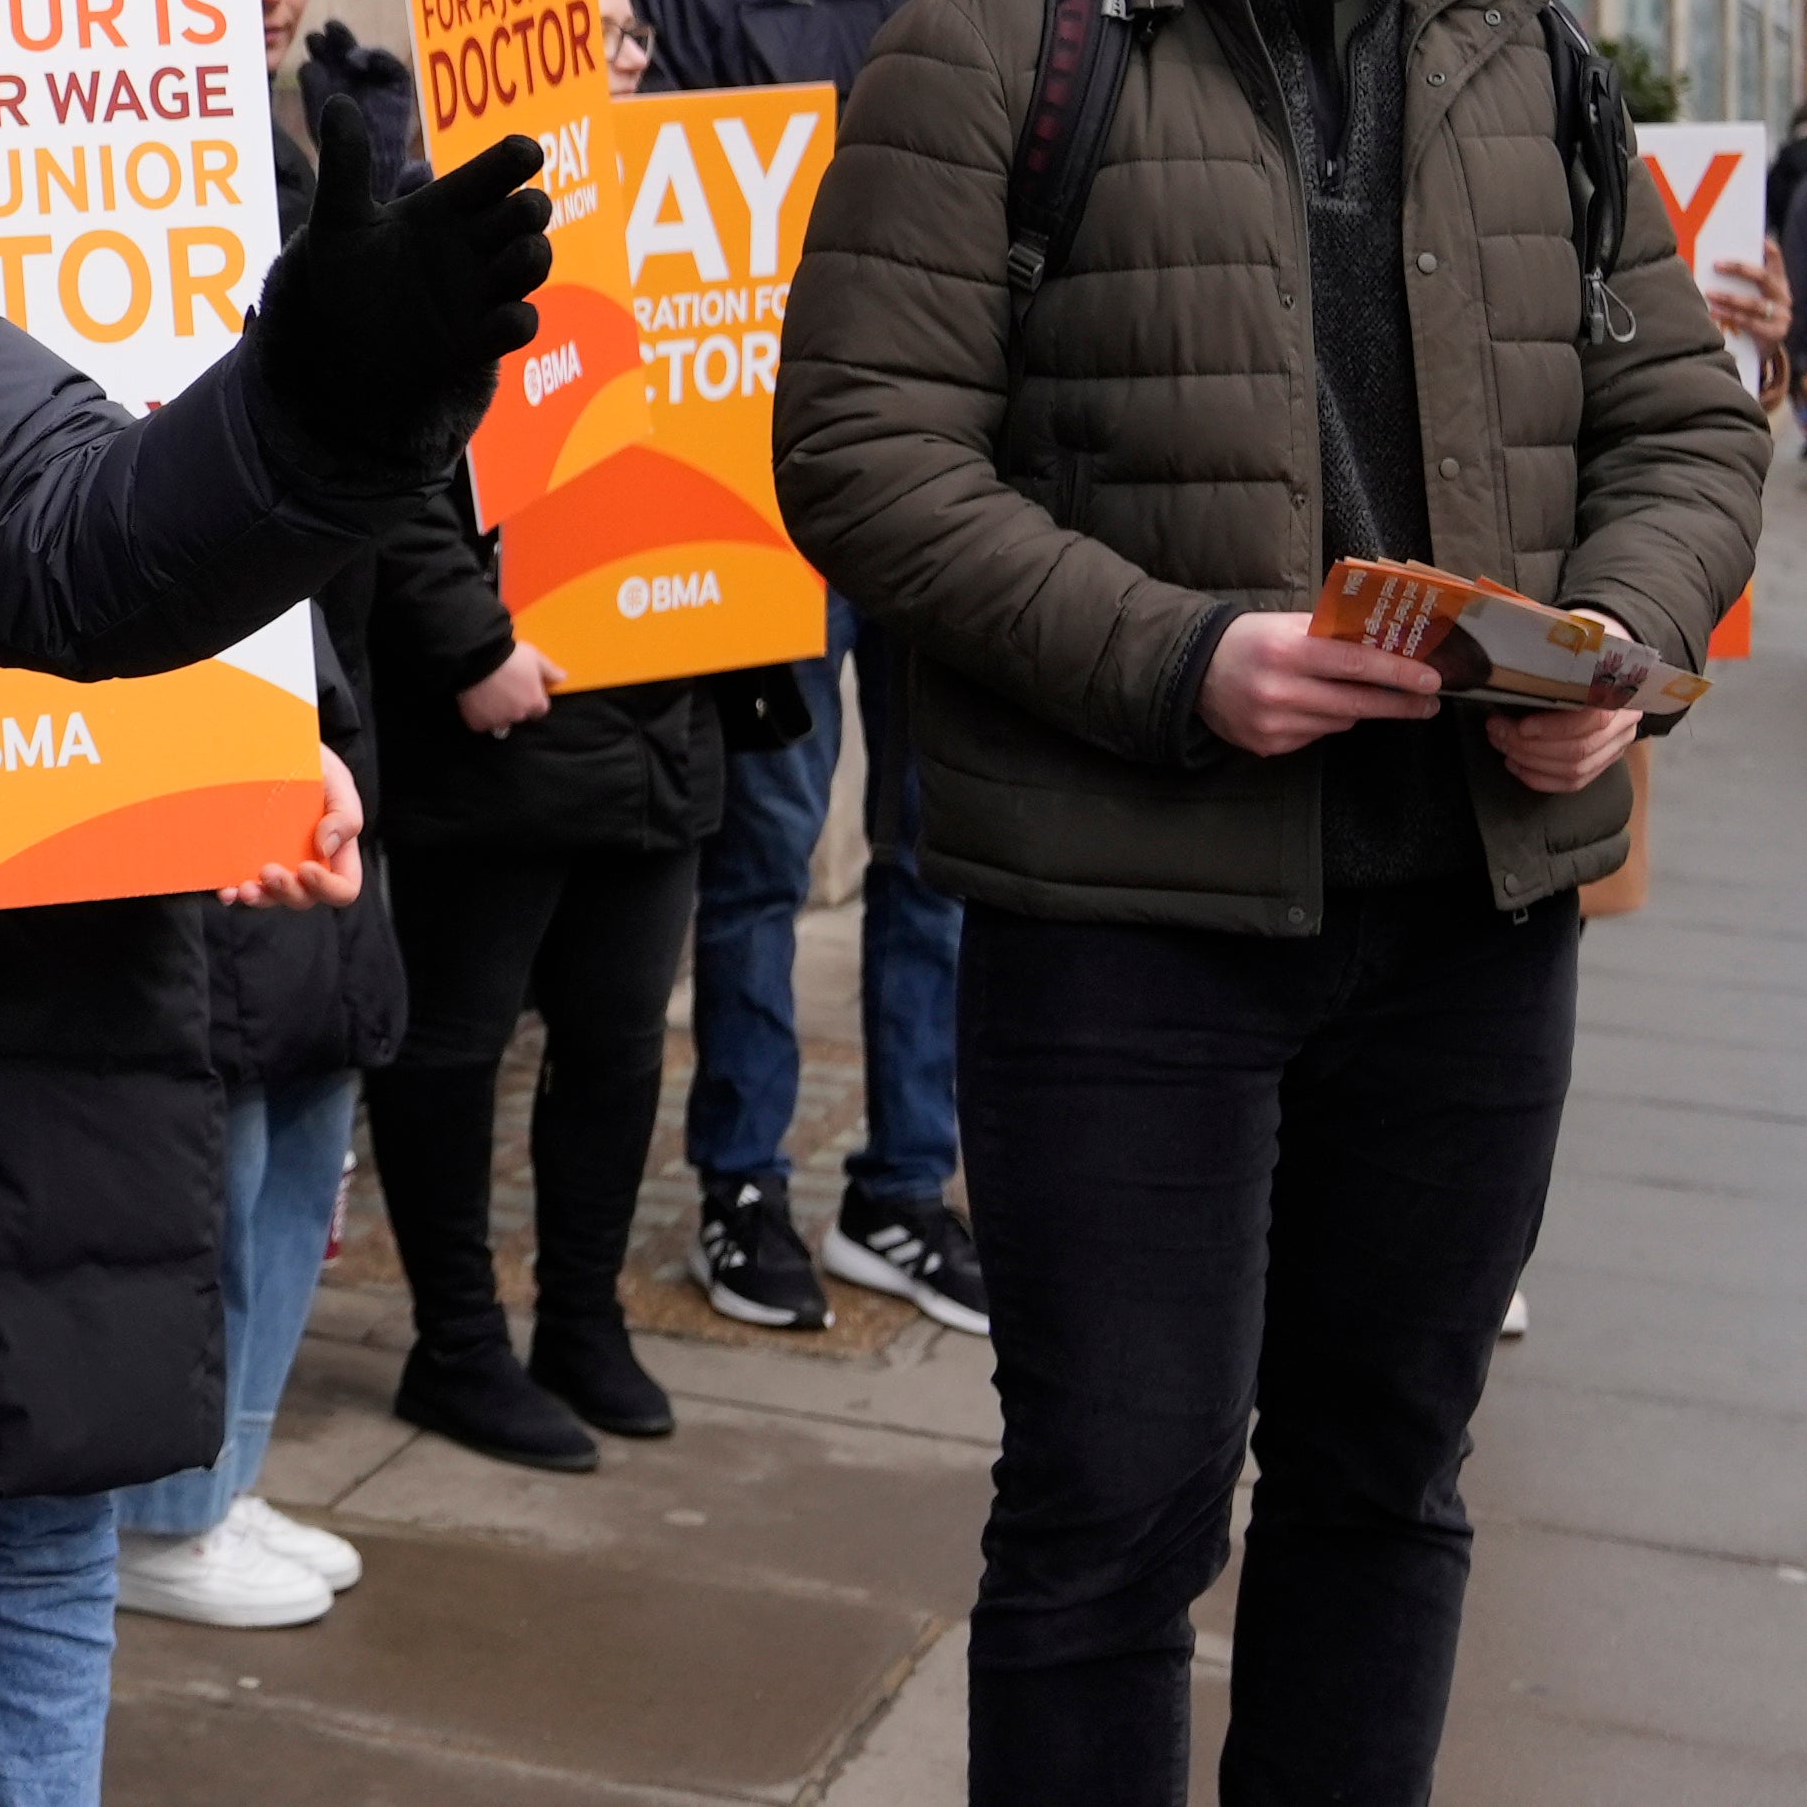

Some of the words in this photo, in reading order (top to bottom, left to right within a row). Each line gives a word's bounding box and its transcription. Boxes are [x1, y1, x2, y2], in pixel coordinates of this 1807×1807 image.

[45, 66, 234, 122] WAGE
[428, 0, 596, 132] DOCTOR
[539, 115, 590, 193] PAY
[563, 182, 598, 224] NOW
[618, 112, 819, 287] AY
[541, 339, 583, 395] BMA
[640, 330, 781, 405] TOR
[652, 570, 722, 613] BMA
